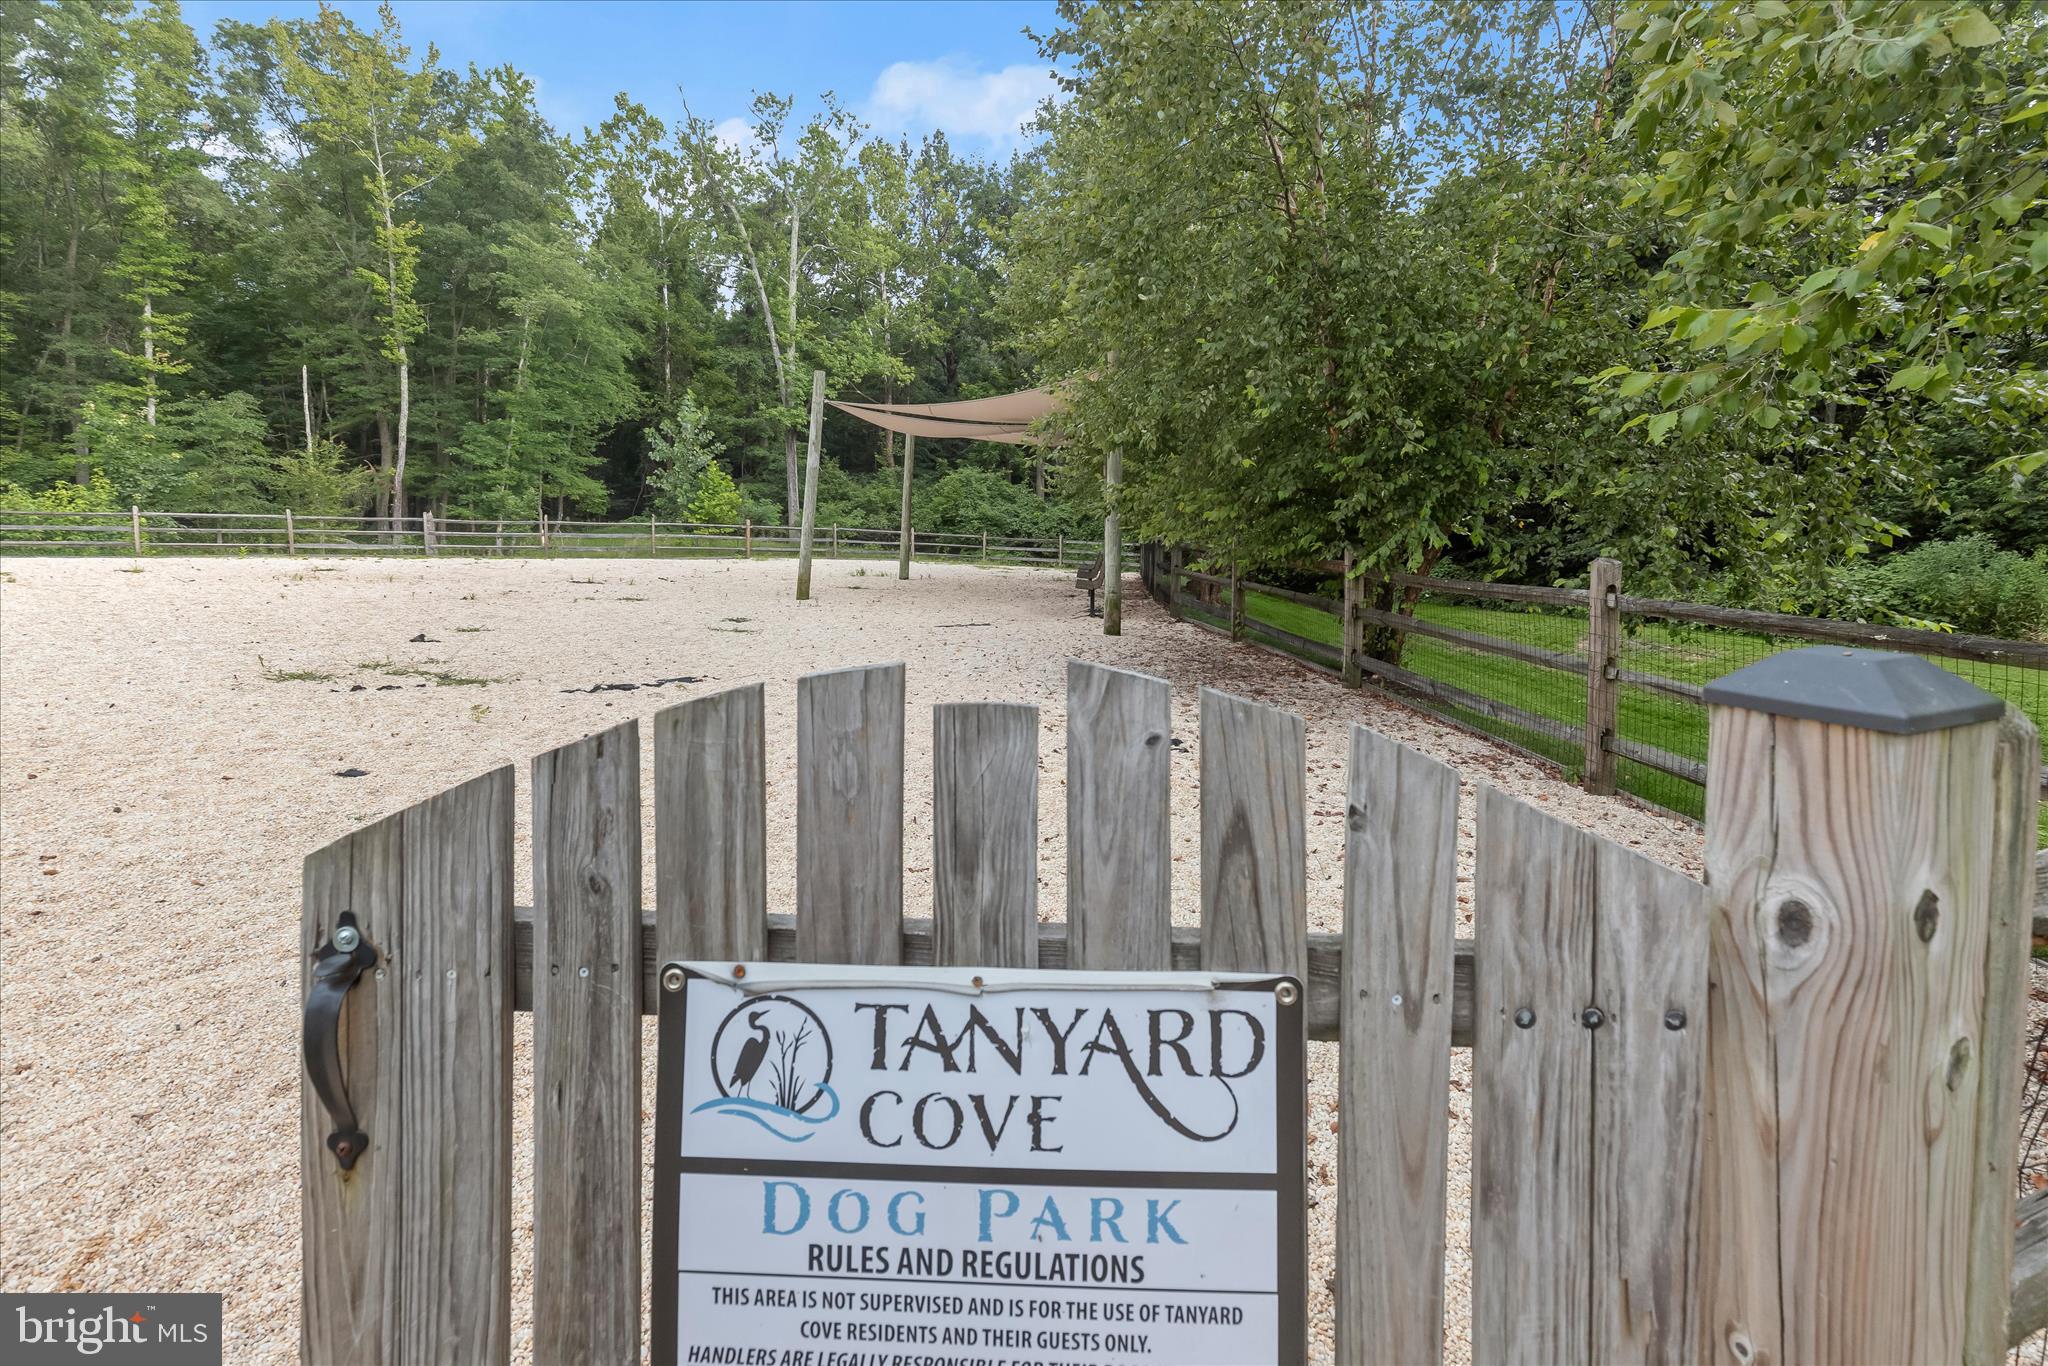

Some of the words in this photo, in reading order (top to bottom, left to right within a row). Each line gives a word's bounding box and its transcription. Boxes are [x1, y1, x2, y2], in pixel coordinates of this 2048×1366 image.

[854, 1002, 1266, 1143] TANYARD
[859, 1090, 1064, 1154] COVE
[762, 1181, 927, 1236] DOG
[977, 1189, 1188, 1245] PARK
[807, 1243, 890, 1275] RULES
[896, 1247, 954, 1277] AND
[962, 1249, 1145, 1284] REGULATIONS
[711, 1286, 750, 1306] THIS
[753, 1288, 798, 1308] AREA
[802, 1290, 818, 1309] IS
[822, 1291, 856, 1311] NOT
[859, 1292, 964, 1315] SUPERVISED
[967, 1297, 1004, 1317] AND
[1009, 1298, 1024, 1318] IS
[1029, 1299, 1062, 1320] FOR
[1065, 1301, 1098, 1321] THE
[1103, 1302, 1135, 1322] USE
[1139, 1303, 1161, 1323] OF
[1164, 1304, 1244, 1326] TANYARD
[687, 1345, 778, 1366] HANDLERS
[779, 1349, 815, 1366] ARE
[800, 1320, 842, 1340] COVE
[847, 1322, 938, 1345] RESIDENTS
[941, 1326, 978, 1346] AND
[981, 1328, 1032, 1349] THEIR
[1036, 1330, 1100, 1352] GUESTS
[1104, 1333, 1152, 1354] ONLY.
